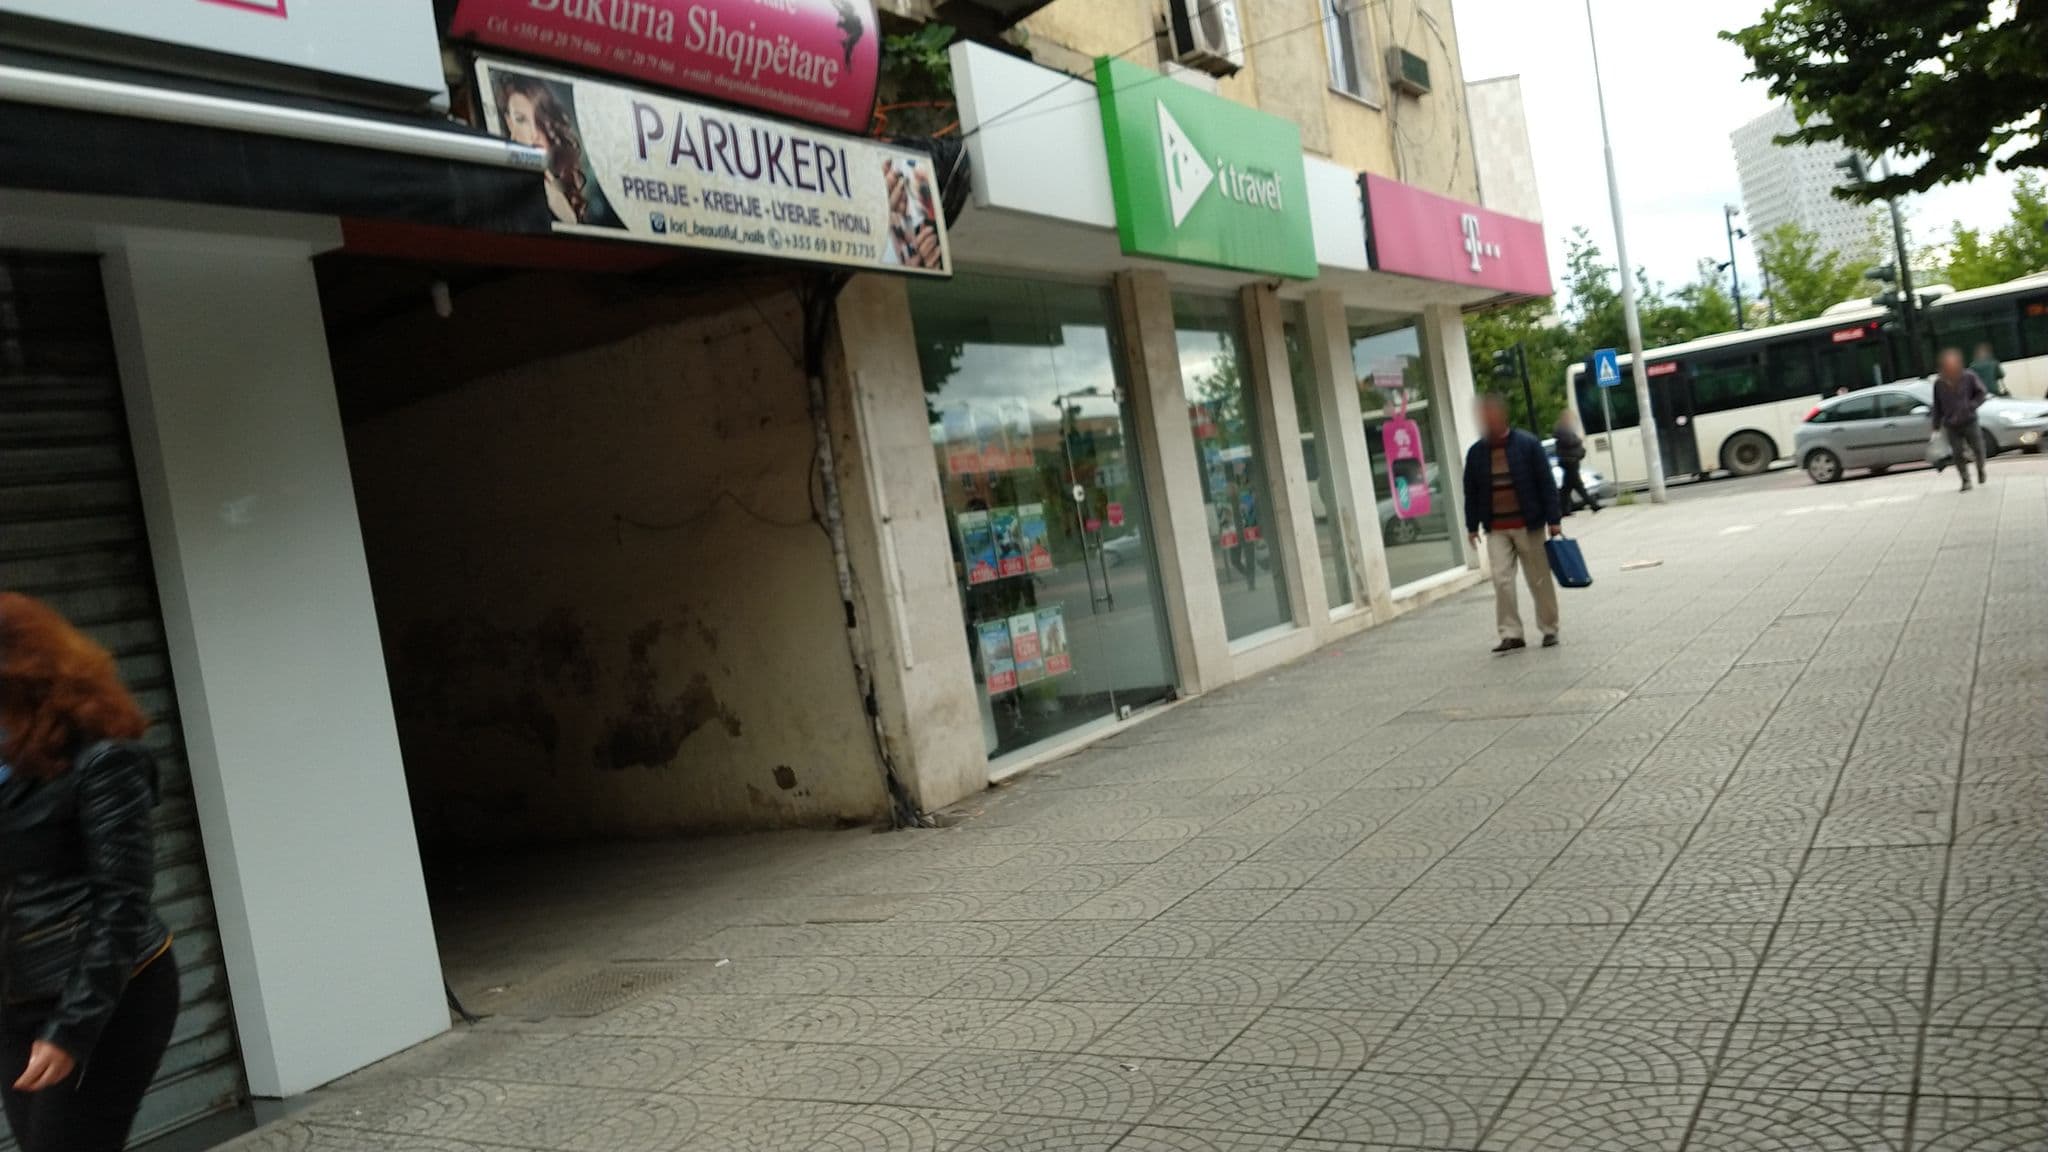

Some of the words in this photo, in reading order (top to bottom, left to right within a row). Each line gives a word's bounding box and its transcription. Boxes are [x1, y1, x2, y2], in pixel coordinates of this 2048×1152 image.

[529, 0, 674, 43] ukuria
[685, 5, 839, 88] Shqipëtare
[632, 100, 852, 199] PARUKERI
[622, 176, 690, 207] PRERJE
[701, 189, 763, 219] KREHJE
[771, 201, 822, 228] LYERJE
[1229, 163, 1283, 211] travel
